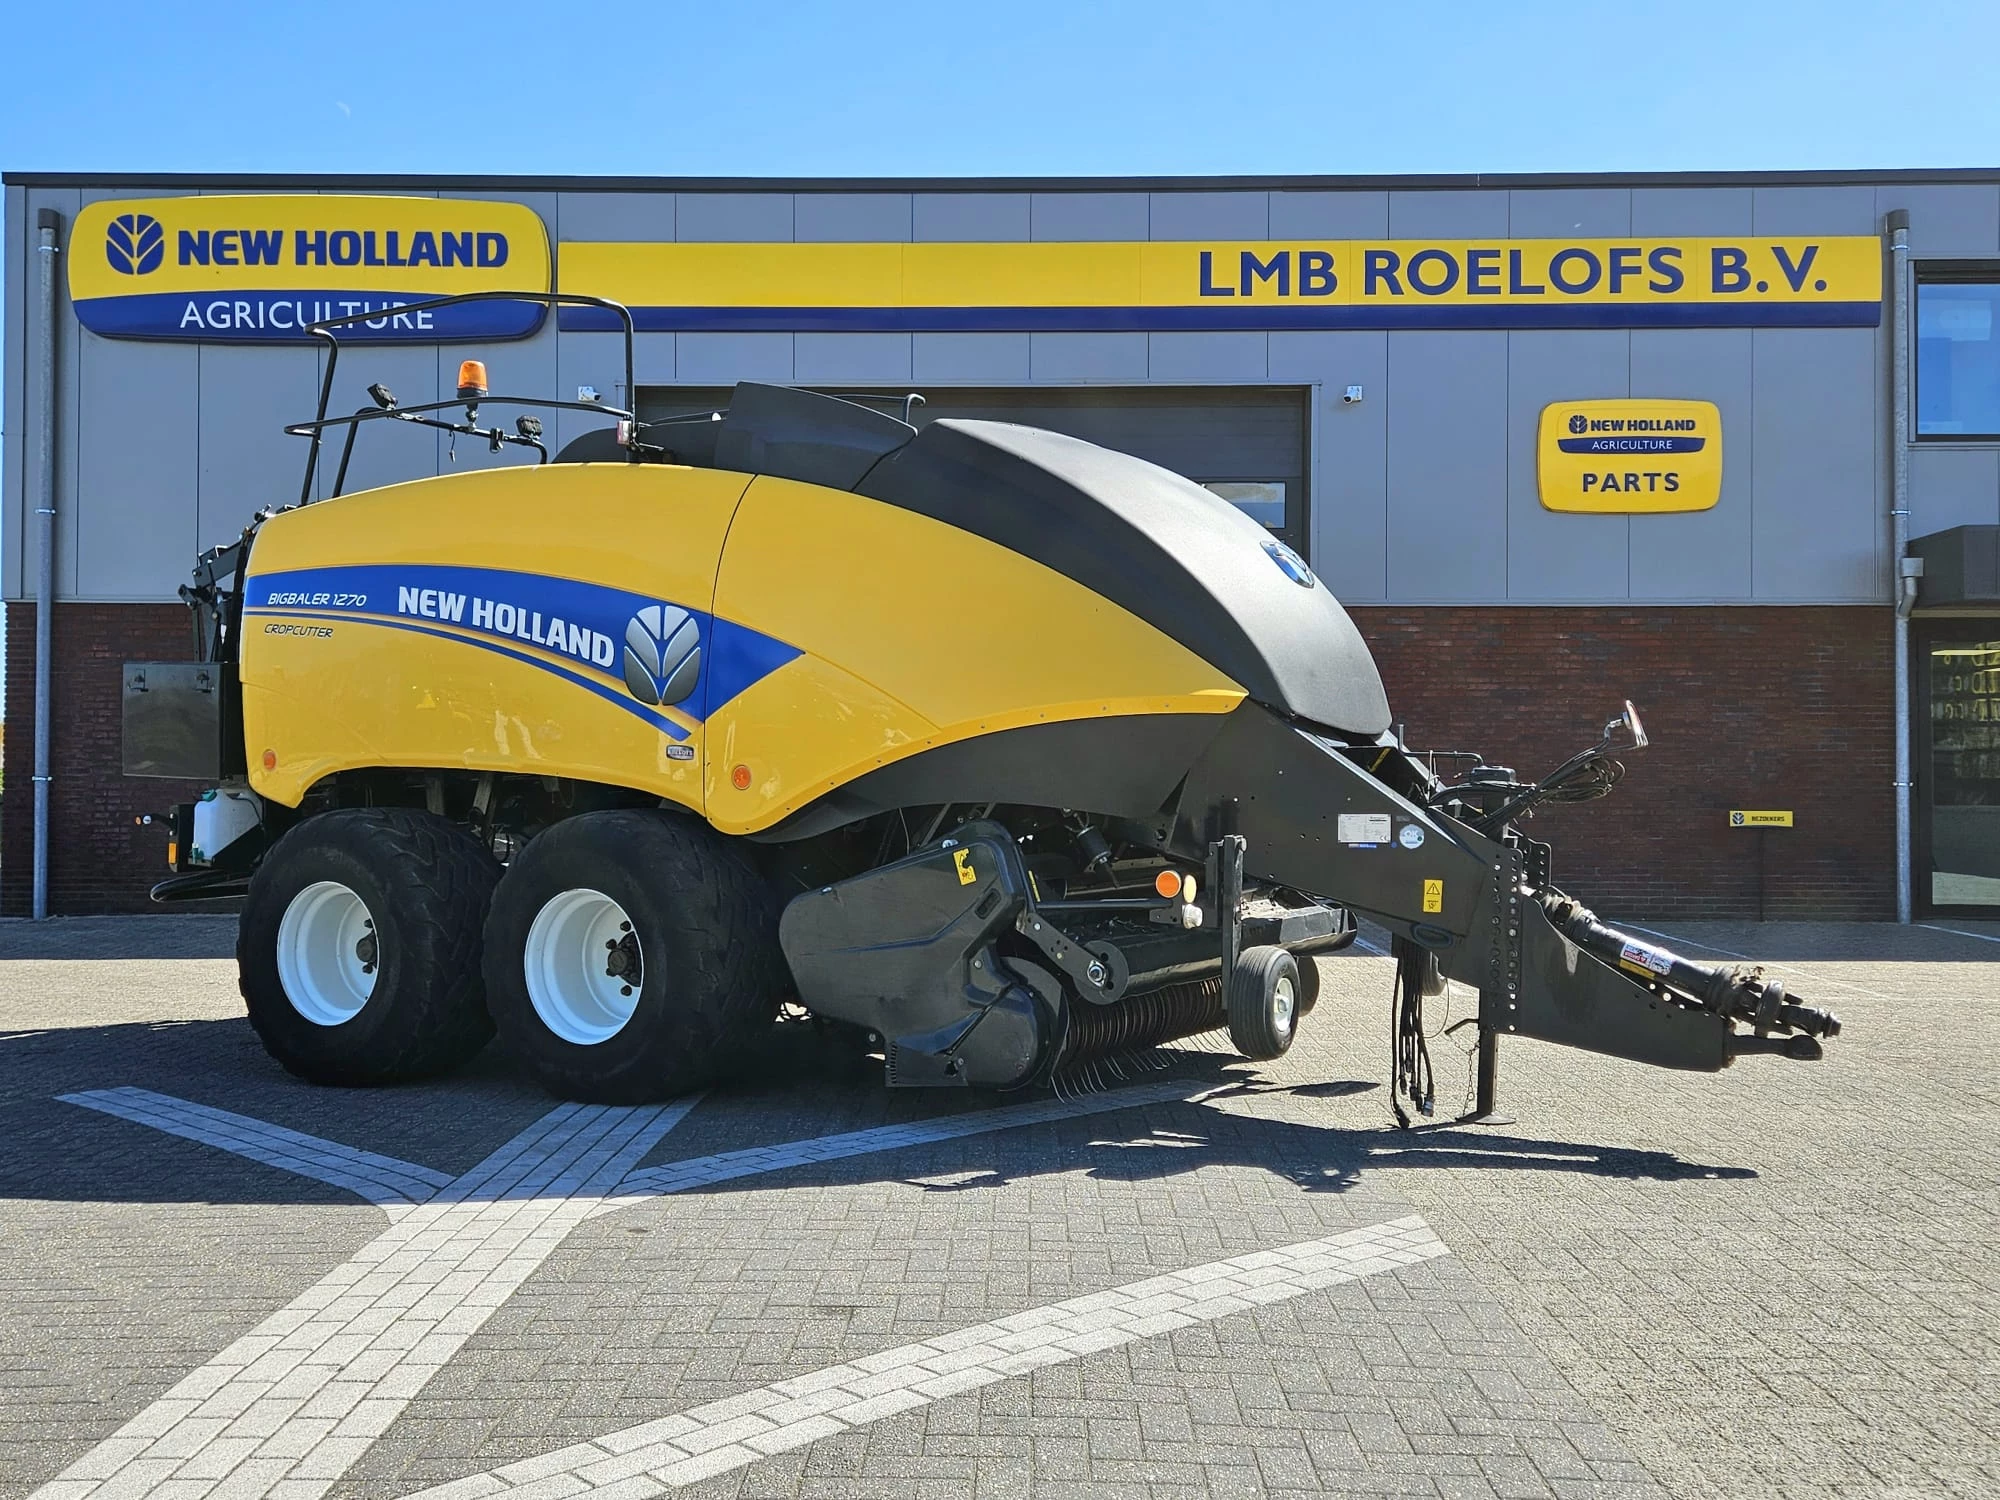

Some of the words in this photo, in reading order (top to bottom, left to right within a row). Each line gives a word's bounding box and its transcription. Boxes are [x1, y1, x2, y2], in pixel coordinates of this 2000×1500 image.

[178, 230, 284, 266] NEW
[295, 230, 509, 268] HOLLAND
[1200, 251, 1338, 297] LMB
[1364, 246, 1685, 296] ROELOFS
[1711, 245, 1827, 294] B.V.
[179, 300, 435, 330] AGRICULTURE
[1590, 419, 1625, 431] NEW
[1627, 419, 1696, 431] HOLLAND
[1591, 440, 1673, 450] AGRICULTURE
[1582, 472, 1680, 492] PARTS
[267, 592, 330, 606] BIGBALER
[332, 593, 368, 607] 1270
[264, 623, 334, 638] CROPCUTTER
[398, 586, 467, 623] NEW
[471, 597, 615, 669] HOLLAND
